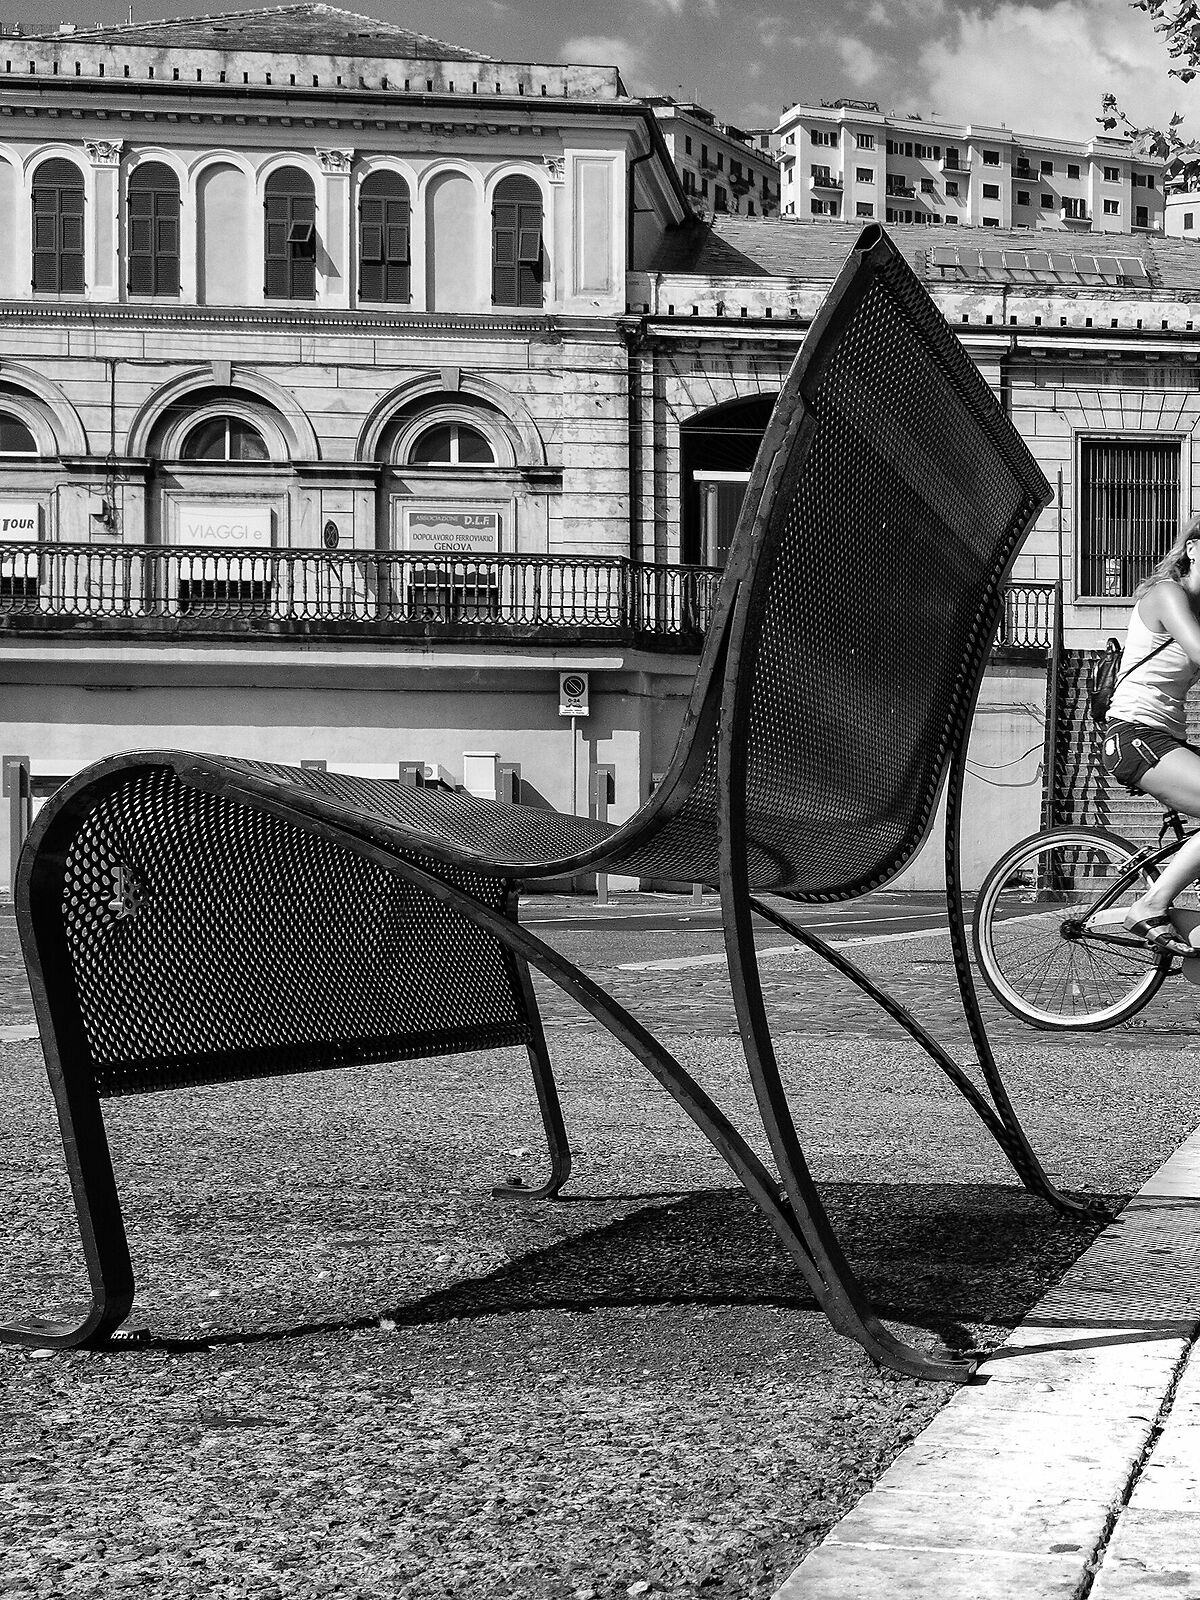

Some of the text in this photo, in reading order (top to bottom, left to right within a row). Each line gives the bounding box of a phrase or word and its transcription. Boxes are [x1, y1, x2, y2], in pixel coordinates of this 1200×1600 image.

[2, 518, 34, 531] TOUR
[188, 525, 262, 539] VIAGGI e
[412, 533, 494, 542] DOPOLAVORO FERROVIARIO
[433, 542, 472, 551] GENOVA
